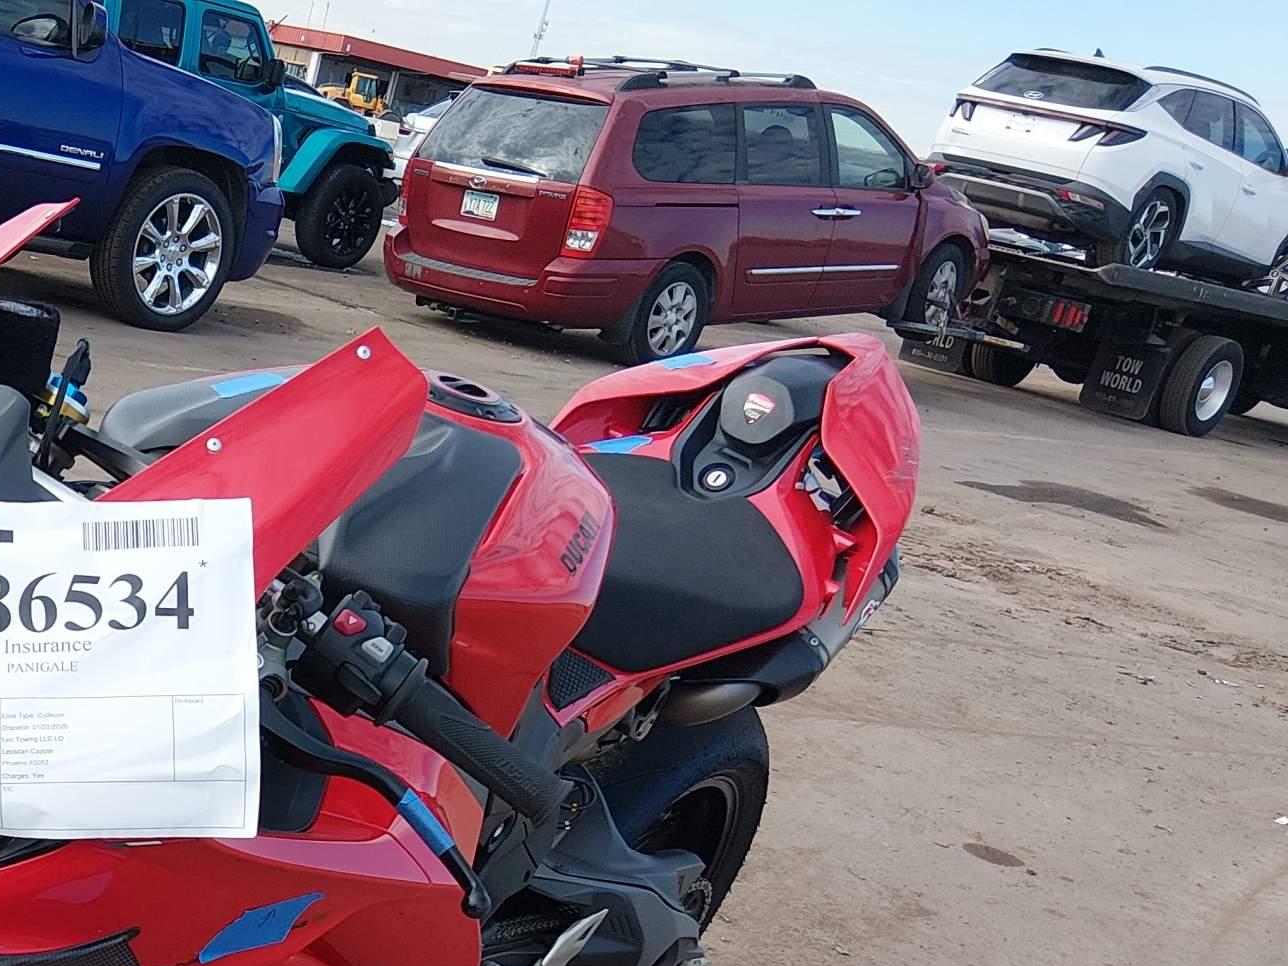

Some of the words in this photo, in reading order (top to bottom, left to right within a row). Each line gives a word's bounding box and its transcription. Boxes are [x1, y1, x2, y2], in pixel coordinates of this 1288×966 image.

[60, 144, 104, 159] DENALI
[1115, 355, 1143, 375] TOW
[1100, 369, 1142, 393] WORLD
[560, 511, 601, 576] DUCATI
[4, 638, 92, 655] Insurance
[7, 660, 79, 674] PANIGALE
